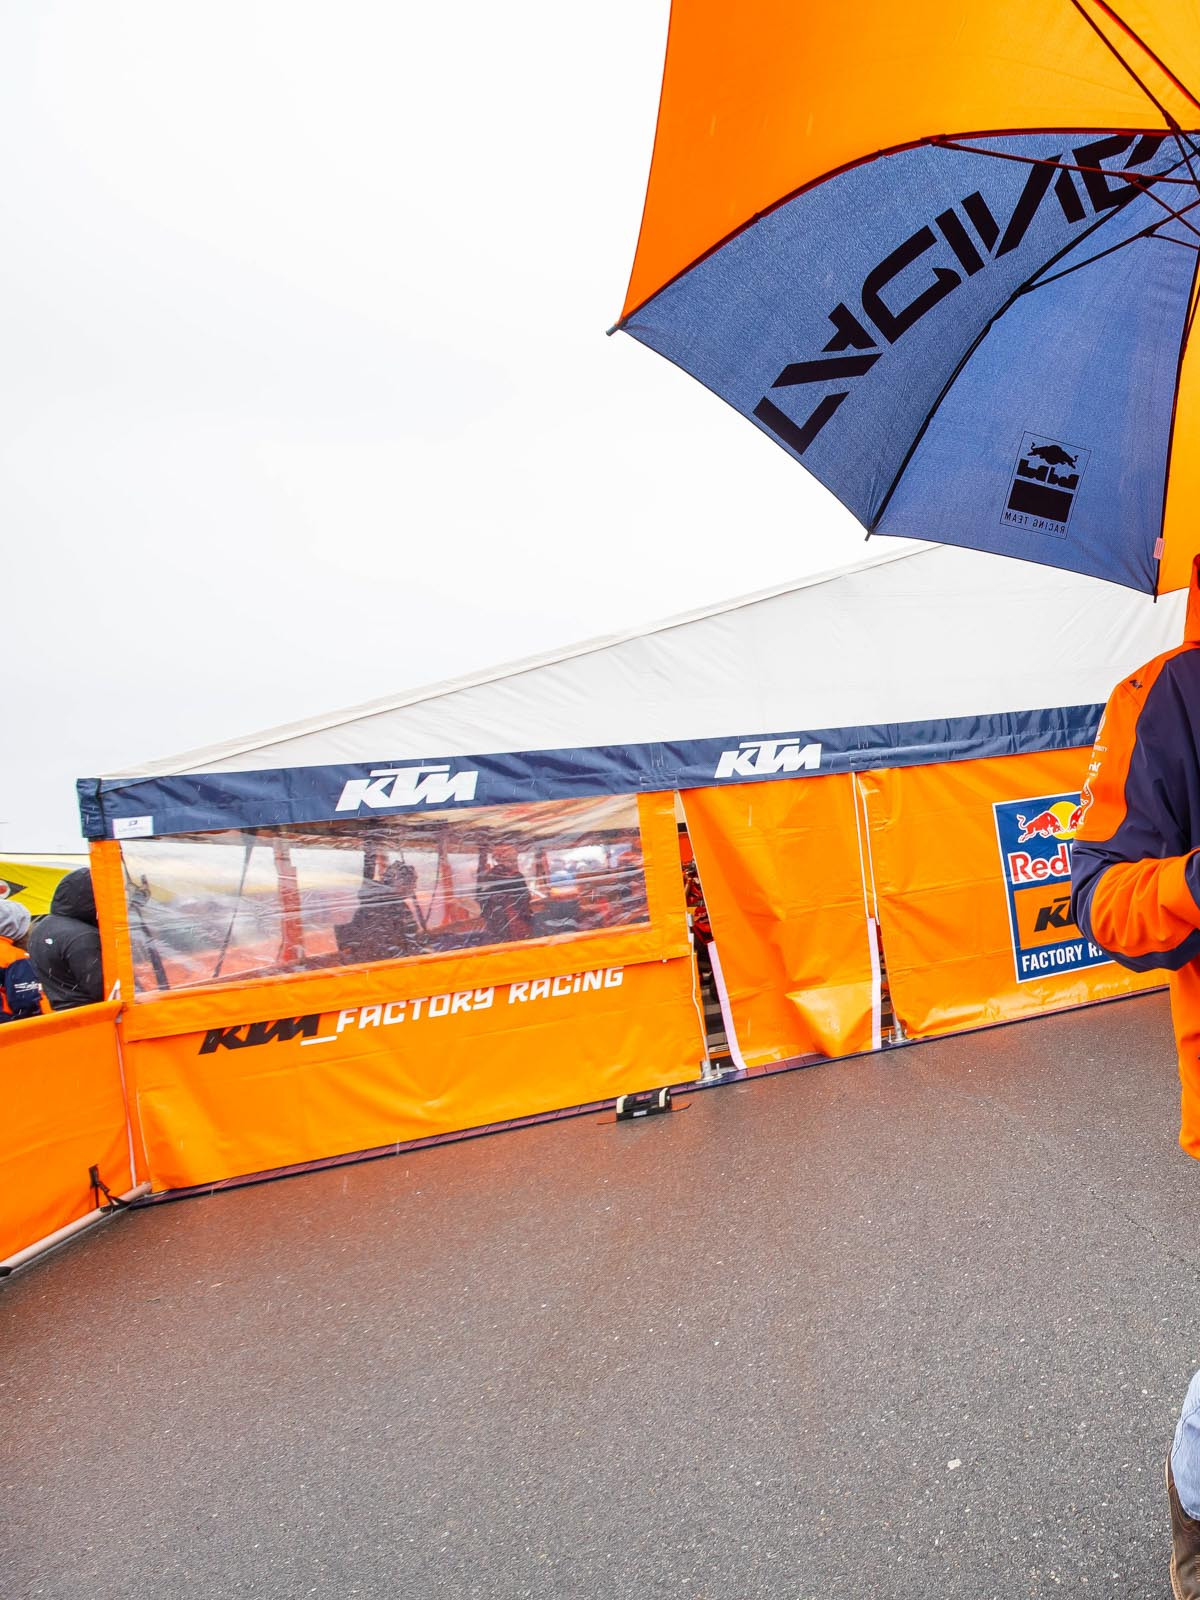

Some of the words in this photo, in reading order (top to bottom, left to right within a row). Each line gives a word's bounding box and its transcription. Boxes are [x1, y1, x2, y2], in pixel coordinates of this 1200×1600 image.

[714, 739, 822, 779] KTM
[335, 765, 478, 811] KTM
[1008, 843, 1072, 884] Red
[1022, 943, 1083, 972] FACTORY
[336, 986, 495, 1033] FACTORY
